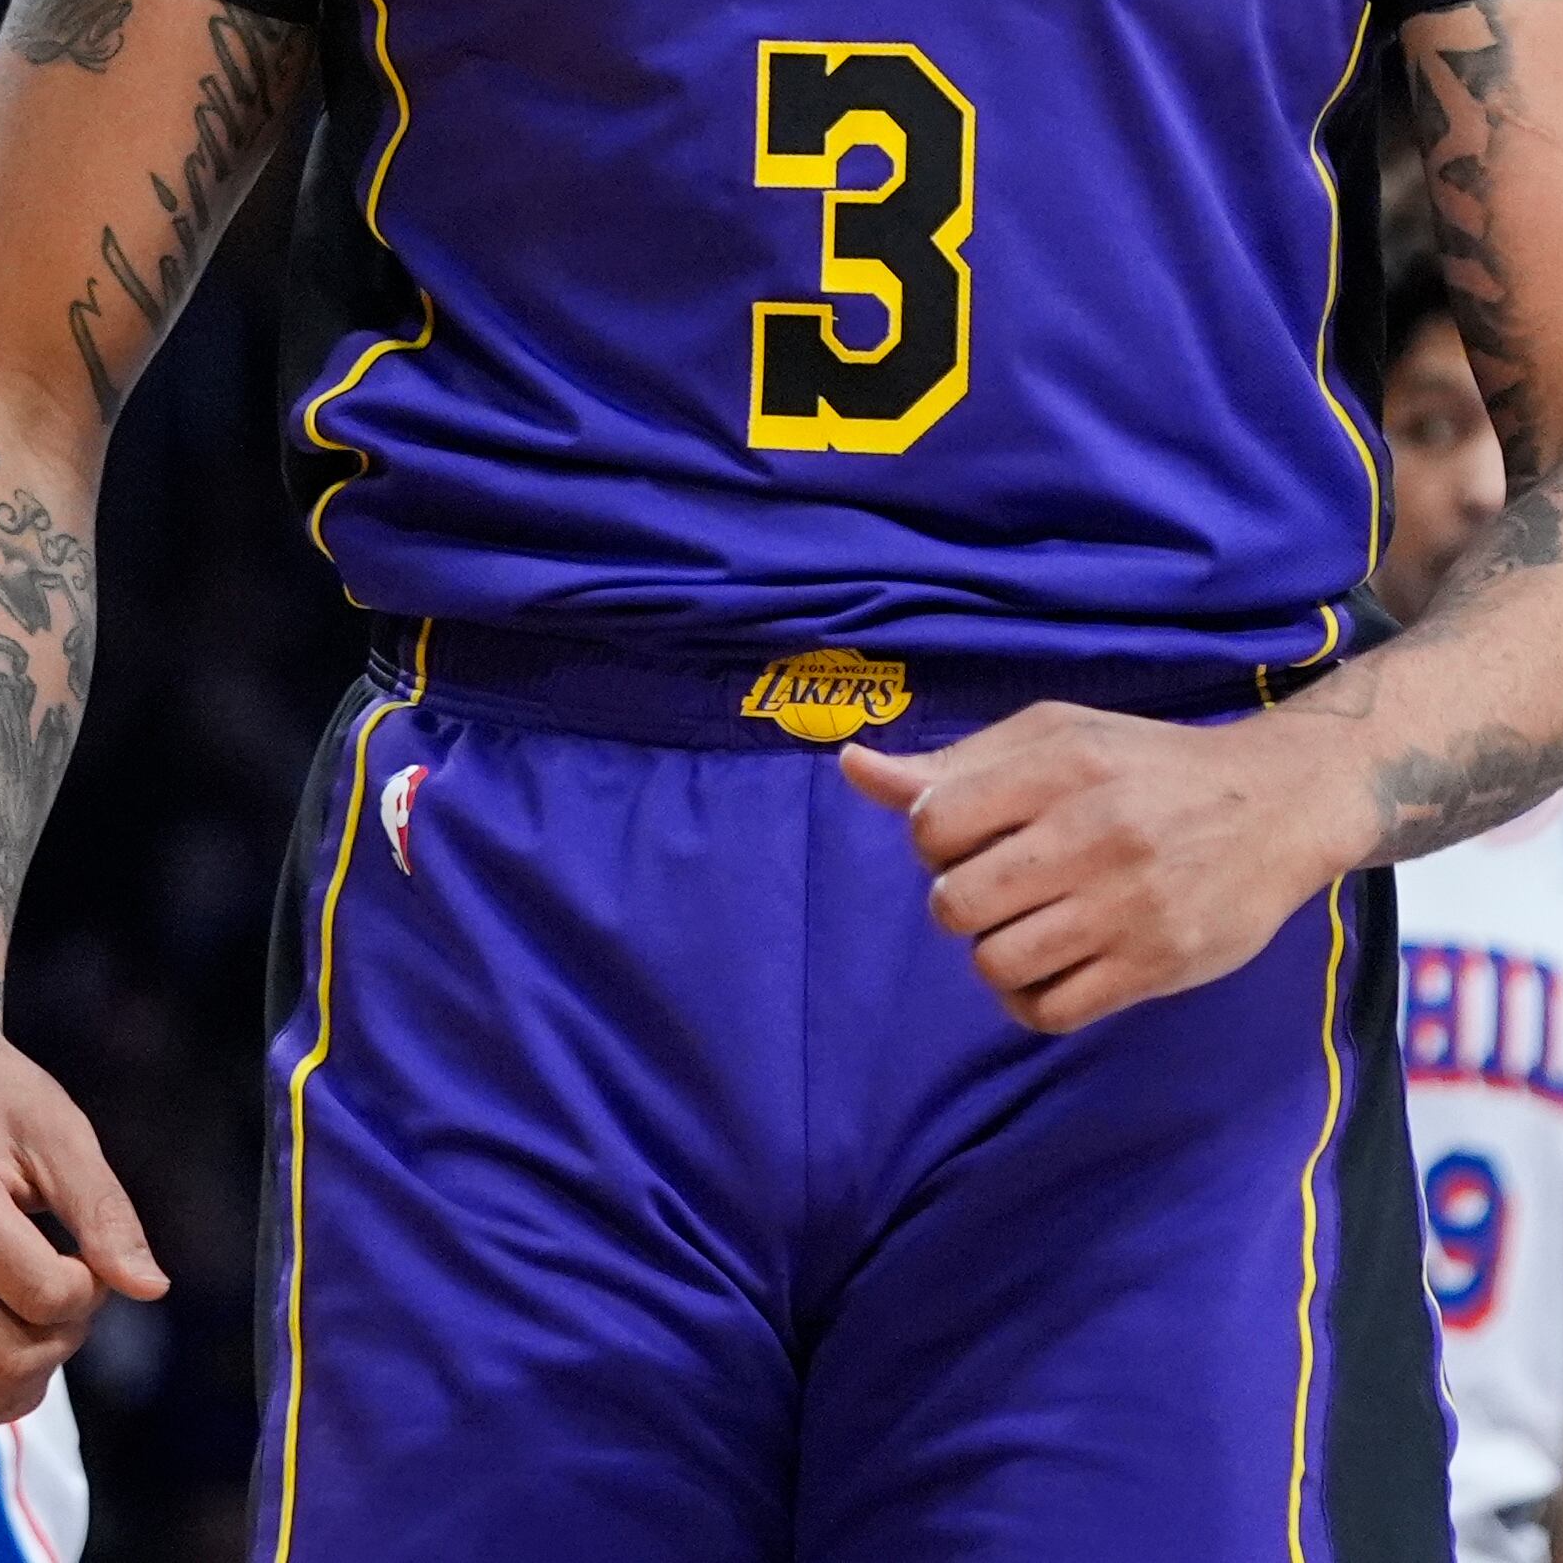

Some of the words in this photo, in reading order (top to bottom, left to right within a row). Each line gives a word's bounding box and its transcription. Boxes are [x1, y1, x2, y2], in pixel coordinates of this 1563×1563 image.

[748, 40, 976, 456] 3
[749, 664, 904, 719] LAKERS
[798, 664, 826, 674] LOS
